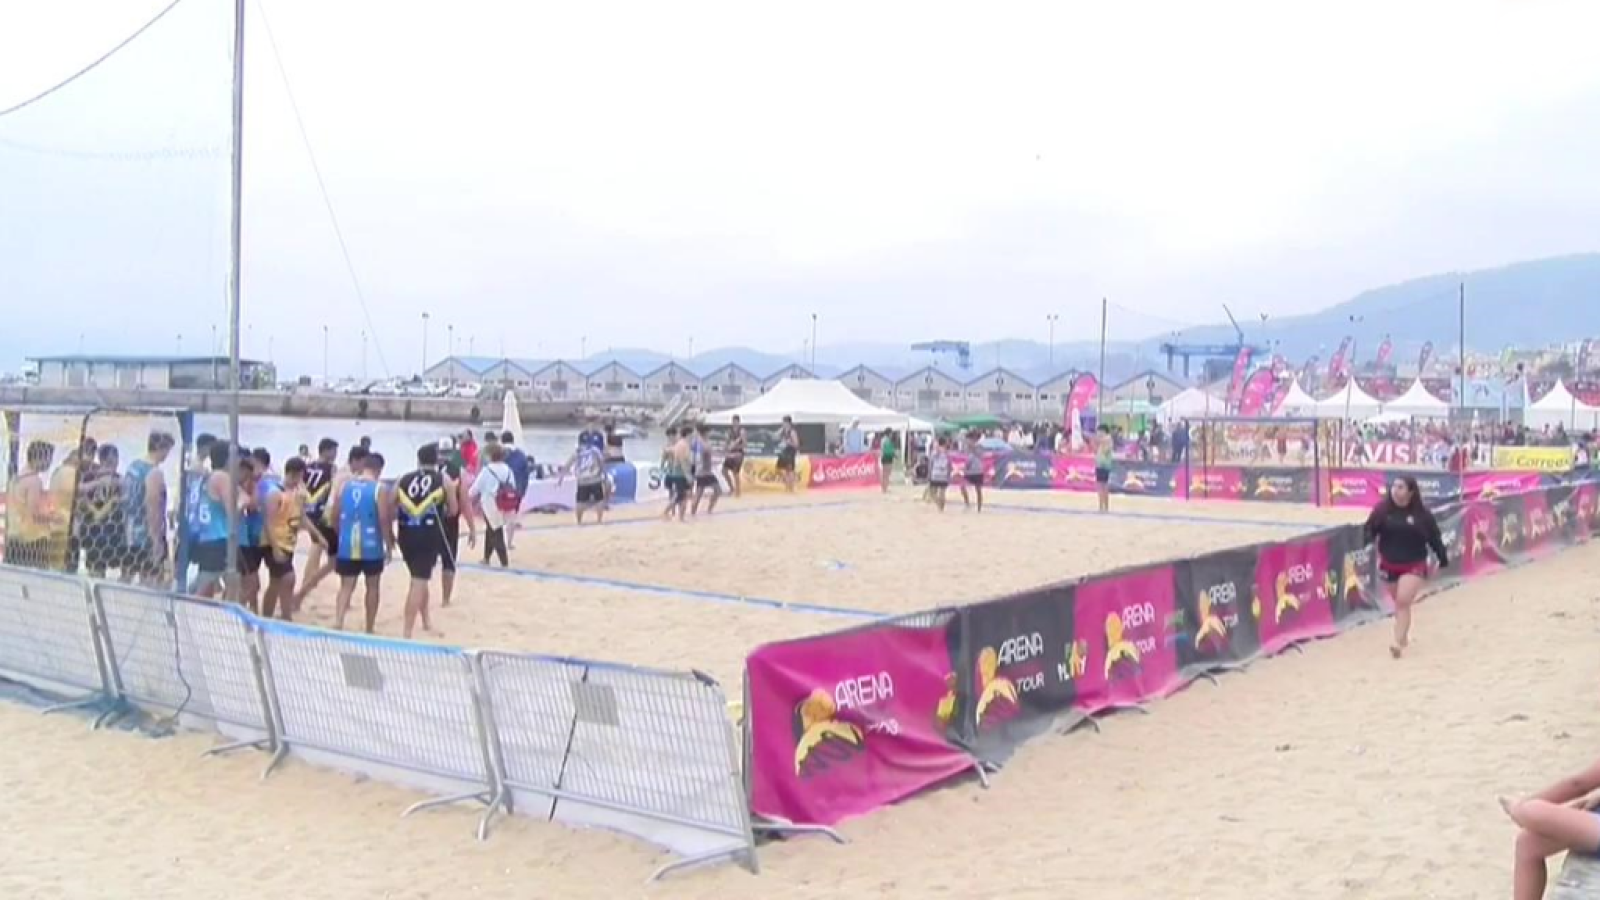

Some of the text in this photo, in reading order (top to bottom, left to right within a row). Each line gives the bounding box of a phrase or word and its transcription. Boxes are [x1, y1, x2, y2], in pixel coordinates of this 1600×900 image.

[305, 468, 323, 488] 77
[407, 474, 432, 498] 69
[352, 488, 362, 507] 9
[199, 504, 212, 525] 6
[1121, 602, 1156, 630] ARENA
[997, 632, 1045, 667] ARENA
[835, 671, 895, 712] ARENA
[1016, 671, 1045, 693] TOUR
